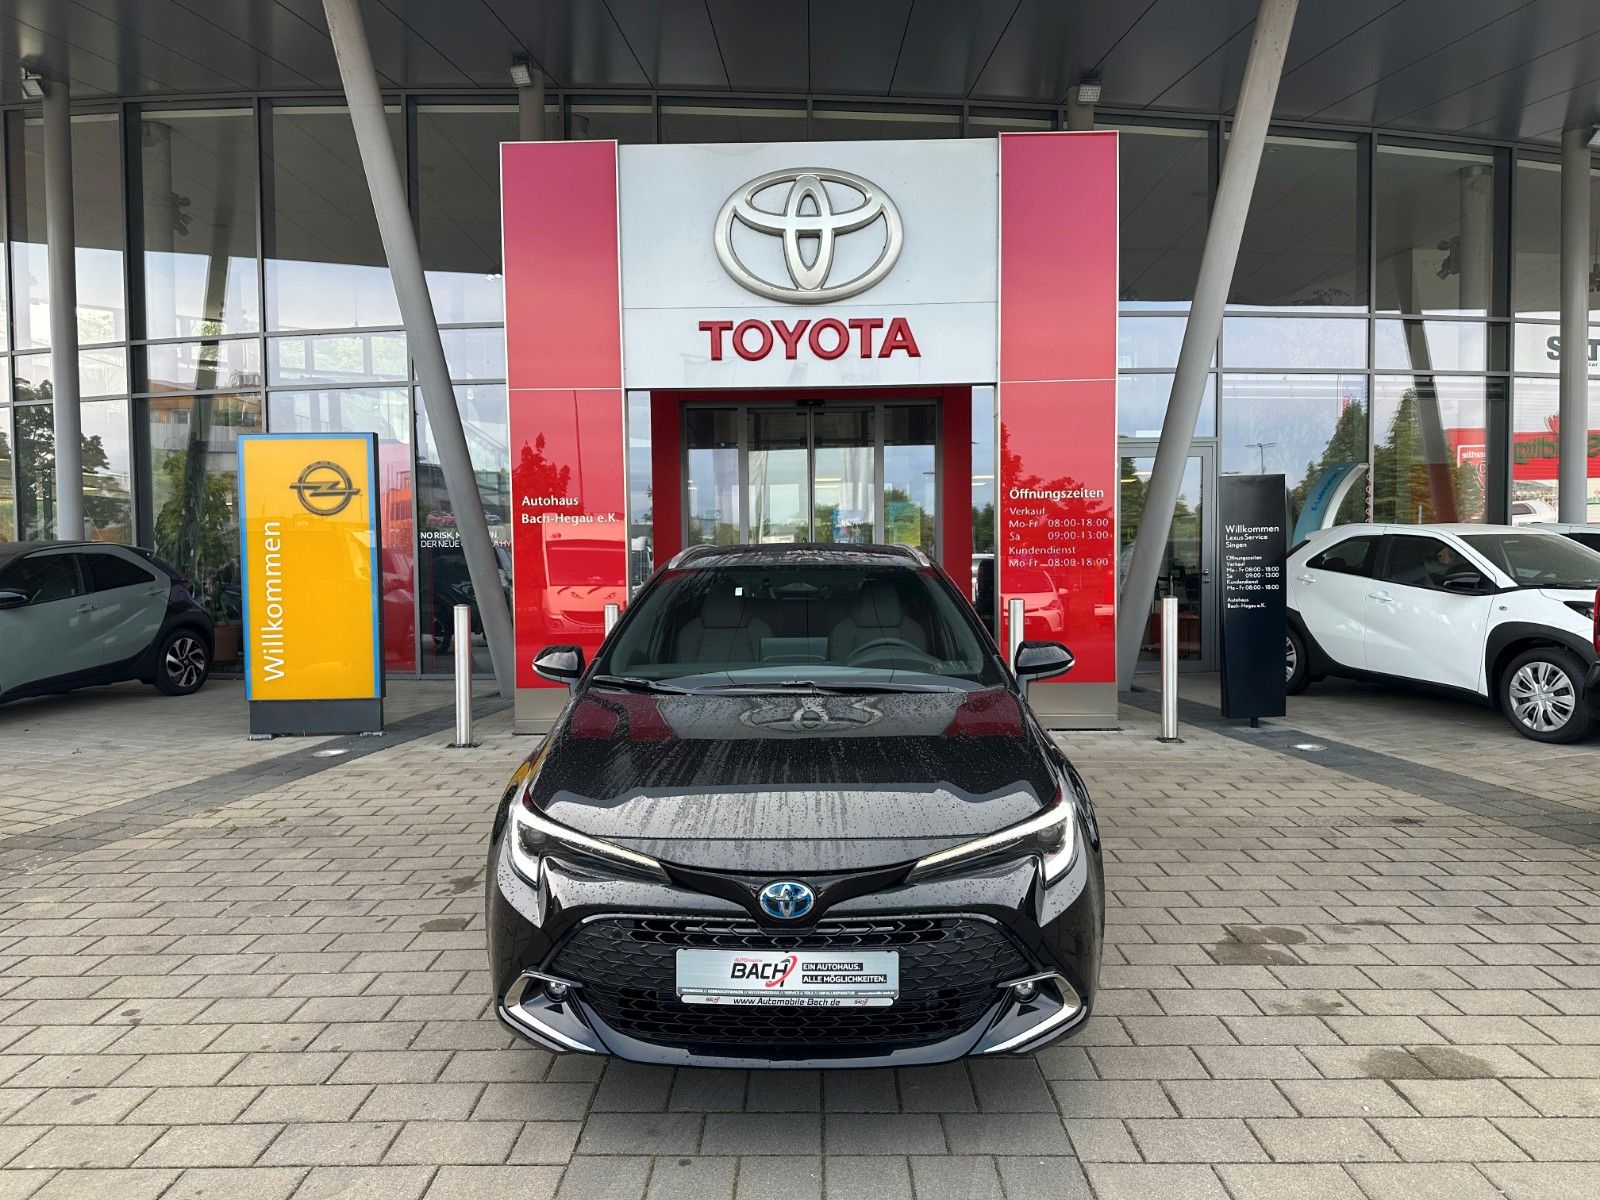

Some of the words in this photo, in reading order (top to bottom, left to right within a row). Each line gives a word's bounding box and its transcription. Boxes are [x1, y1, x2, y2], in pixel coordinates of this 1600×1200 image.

[699, 317, 921, 361] TOYOTA
[1547, 336, 1600, 361] ST
[1009, 487, 1104, 501] Öffnungszeiten
[522, 495, 579, 506] Autohaus
[1009, 506, 1046, 516] Verkauf
[522, 513, 593, 526] Bach-Hegau
[1008, 520, 1038, 528] Mo-Fr
[1047, 518, 1109, 528] 08:00-18:00
[1226, 525, 1280, 533] Willkommen
[420, 531, 433, 539] NO
[434, 531, 455, 540] RISK,
[1009, 532, 1021, 541] Sa
[1047, 531, 1109, 540] 09:00-13:00
[420, 540, 437, 548] DER
[438, 540, 460, 548] NEUE
[1225, 541, 1247, 549] Singen
[1008, 546, 1076, 555] Kundendienst
[1008, 559, 1038, 567] Mo-Fr
[1047, 558, 1109, 567] 08:00-18:00
[260, 521, 285, 682] Willkommen
[803, 963, 816, 971] EIN
[816, 963, 861, 971] AUTOHAUS.
[731, 962, 790, 987] BACH
[803, 975, 823, 983] ALLE
[823, 974, 887, 983] MÖGLICHKEITEN.
